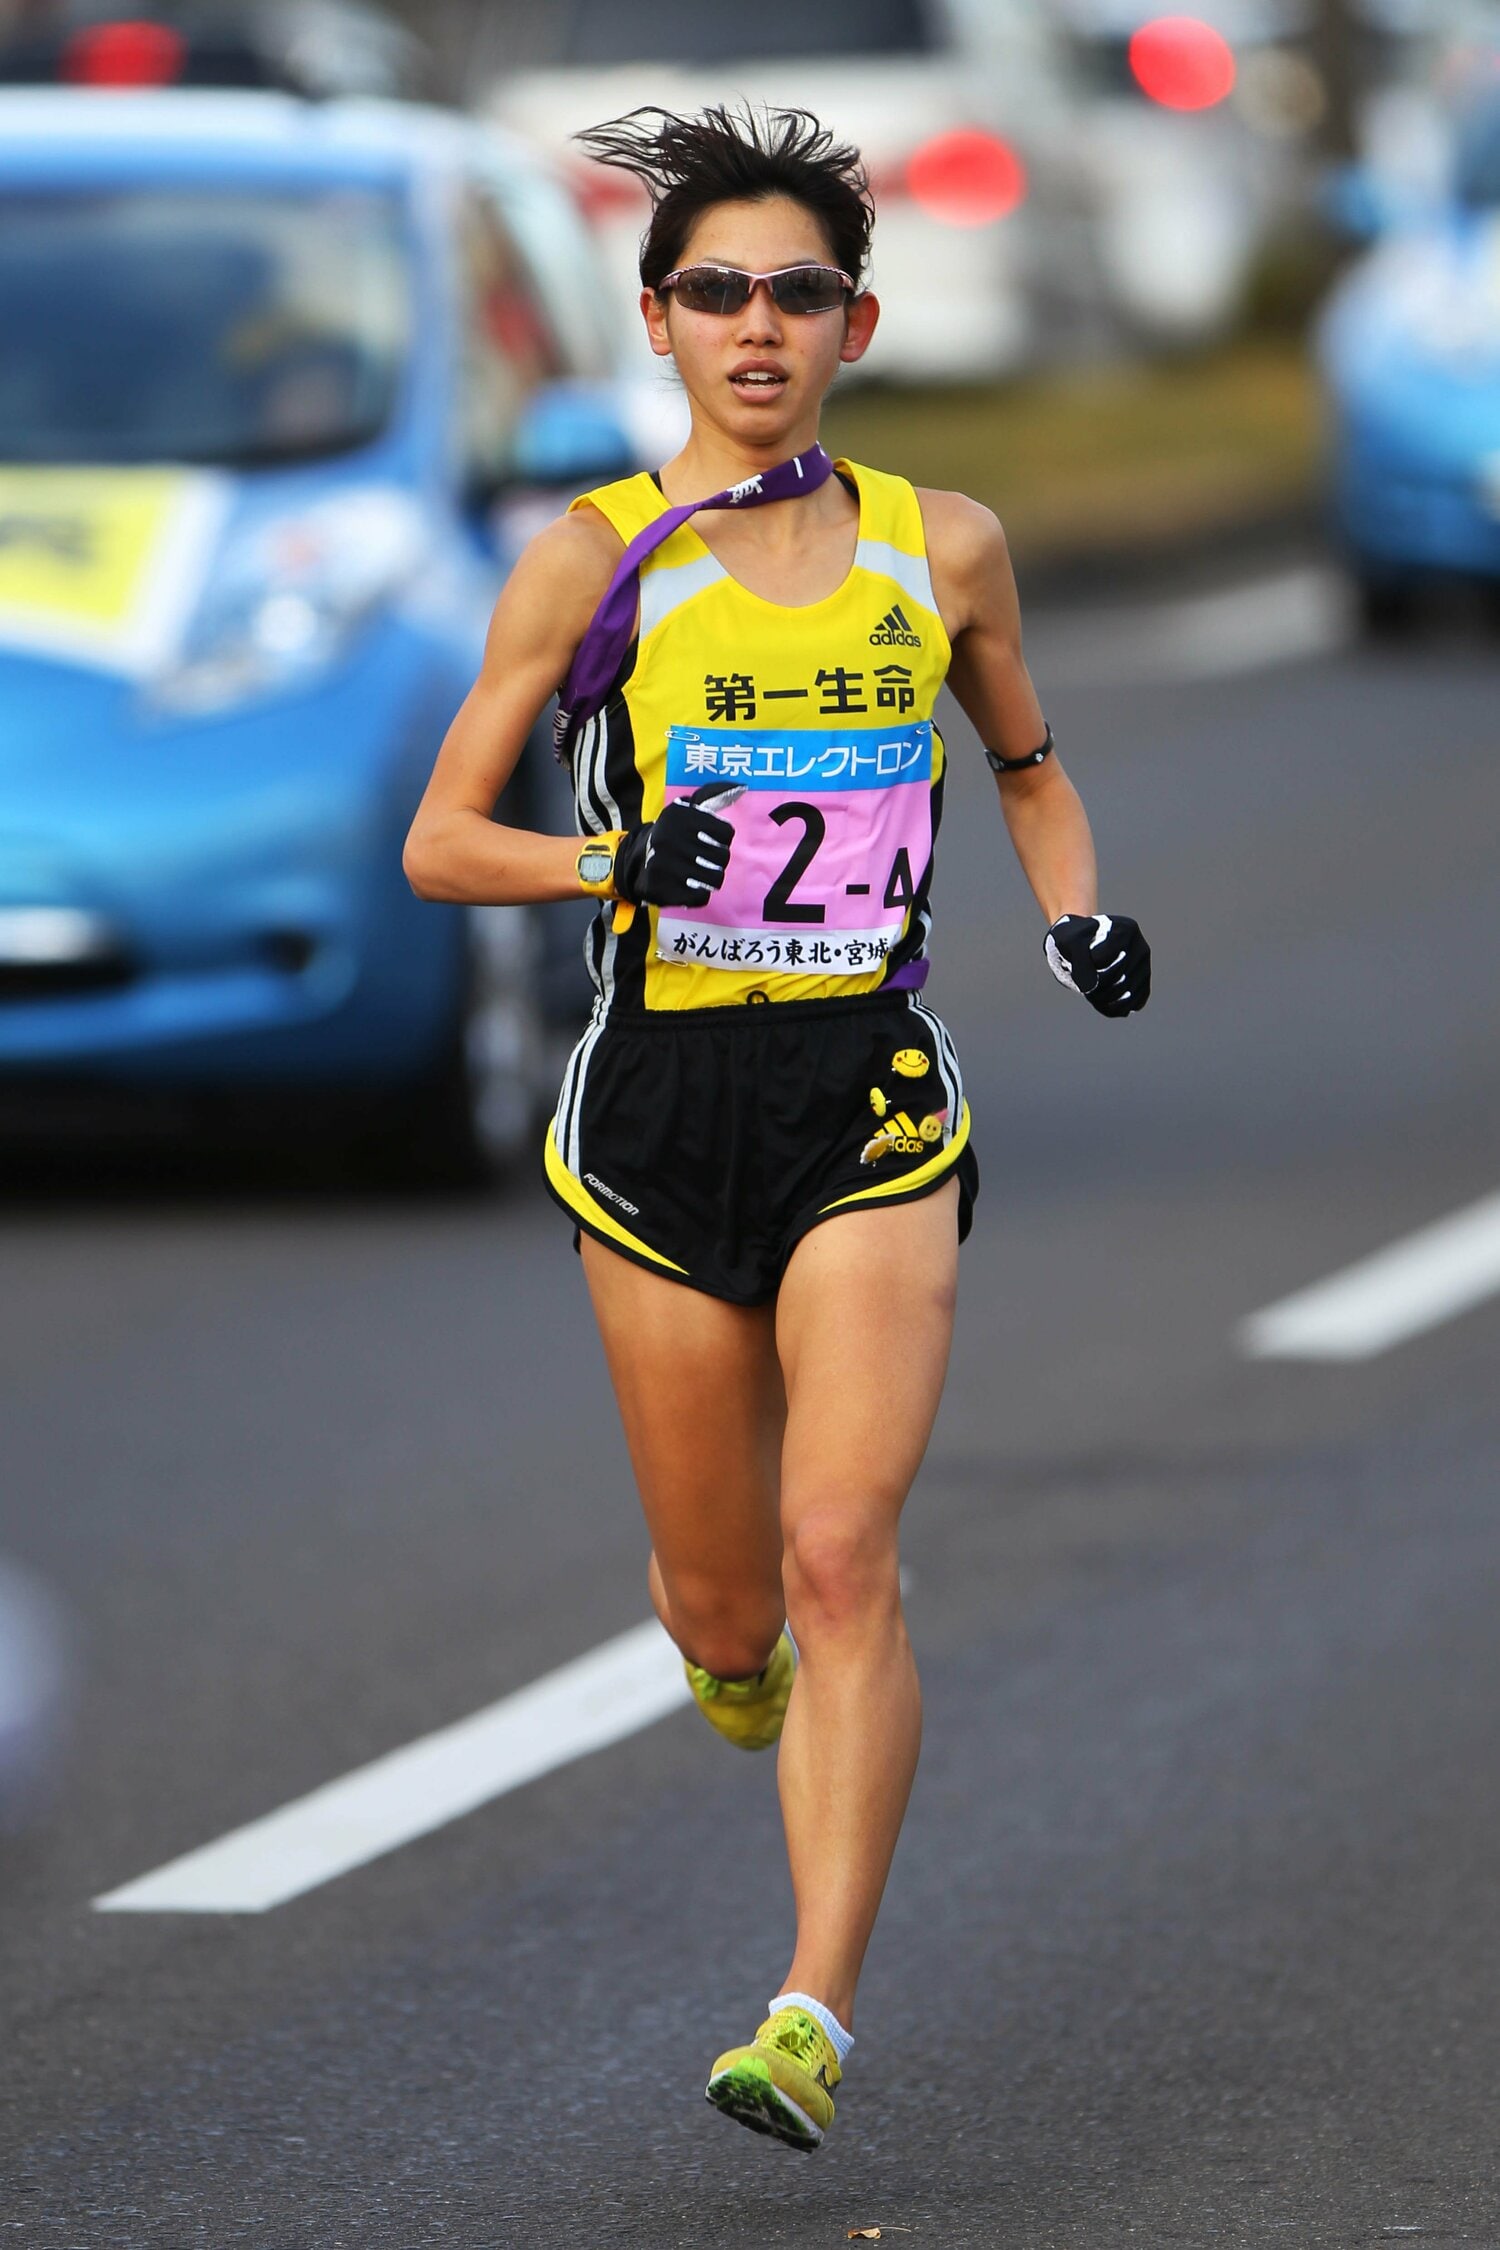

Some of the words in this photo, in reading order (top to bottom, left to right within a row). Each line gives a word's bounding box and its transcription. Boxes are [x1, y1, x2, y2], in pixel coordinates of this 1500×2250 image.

[869, 629, 922, 648] adidas
[703, 664, 915, 722] 第一生命
[684, 741, 923, 778] 東京エレクトロン
[583, 1173, 640, 1216] FORMOTION
